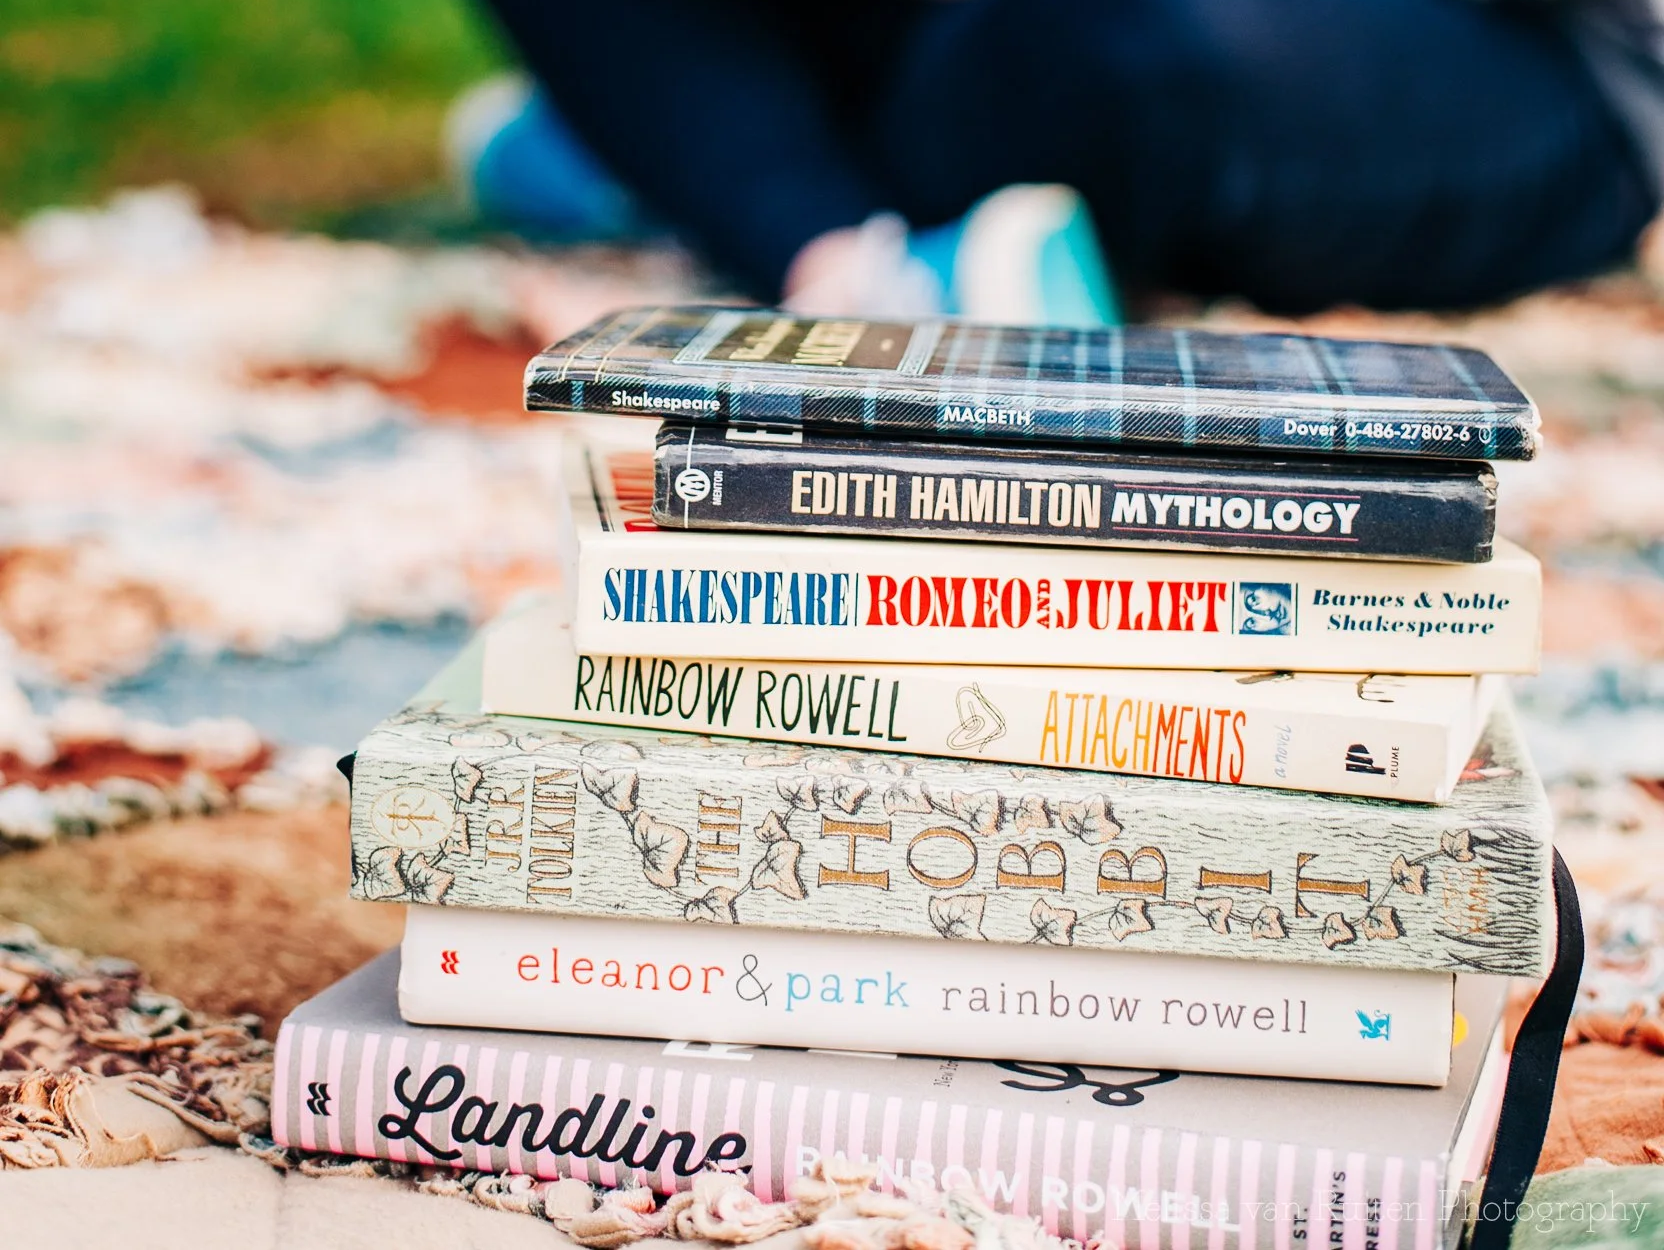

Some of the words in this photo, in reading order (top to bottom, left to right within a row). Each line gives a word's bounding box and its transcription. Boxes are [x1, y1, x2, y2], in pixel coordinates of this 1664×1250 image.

[612, 390, 720, 412] Shakespeare
[944, 406, 1031, 425] MACBETH
[1284, 419, 1338, 437] Dover
[1345, 423, 1470, 442] 0-486-27802-6
[712, 470, 724, 505] MENTOR
[791, 470, 897, 518] EDITH
[910, 476, 1100, 529] HAMILTON
[1111, 492, 1361, 534] MYTHOLOGY
[603, 568, 850, 627] SHAKESPEARE
[866, 575, 1032, 629] ROMEO
[1037, 578, 1051, 628] AND
[1056, 578, 1227, 633] JULIET
[1312, 589, 1405, 610] Barnes
[1413, 591, 1432, 610] &
[1439, 592, 1511, 612] Noble
[1327, 614, 1495, 637] Shakespeare
[574, 656, 744, 727] RAINBOW
[756, 669, 908, 742] ROWELL
[1040, 690, 1246, 784] ATTACHMENTS
[1274, 725, 1292, 767] novel
[1390, 746, 1400, 778] PLUME
[1275, 768, 1287, 779] a
[527, 765, 578, 904] TOLKIEN
[696, 793, 743, 885] THE
[516, 948, 725, 995] eleanor
[736, 953, 773, 1007] &
[784, 970, 910, 1012] park
[942, 980, 1141, 1023] rainbow
[1161, 999, 1309, 1034] rowell
[378, 1065, 752, 1177] Landline
[796, 1145, 1021, 1205] RNBOW
[1041, 1174, 1241, 1232] ROWELL
